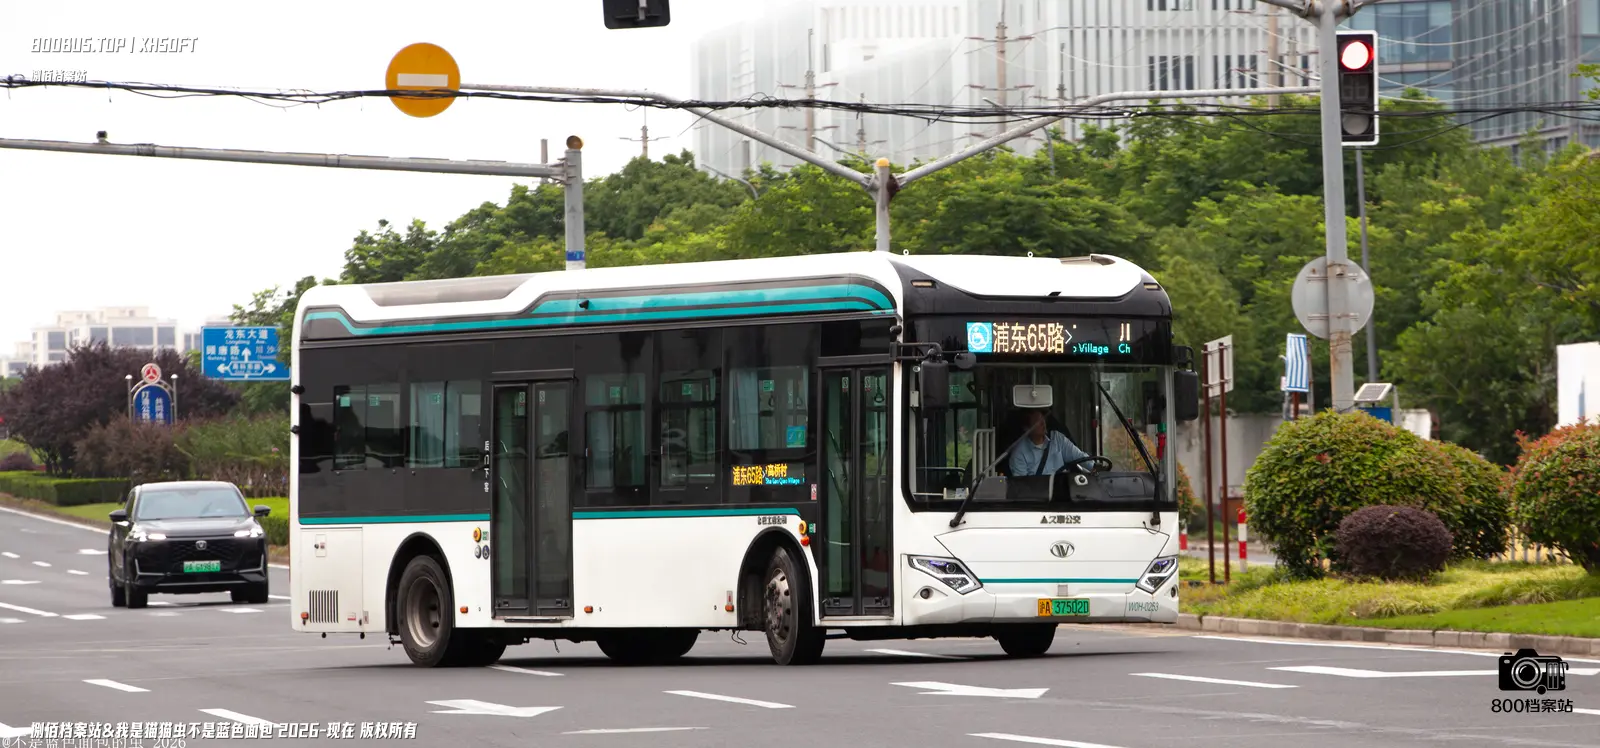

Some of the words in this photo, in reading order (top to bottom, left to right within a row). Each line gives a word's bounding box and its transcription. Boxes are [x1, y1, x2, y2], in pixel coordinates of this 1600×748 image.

[225, 329, 269, 340] 龙东大道
[993, 322, 1065, 353] 浦东65路
[1079, 343, 1109, 355] Village
[732, 465, 763, 486] 浦东65路
[765, 463, 788, 478] 高桥村
